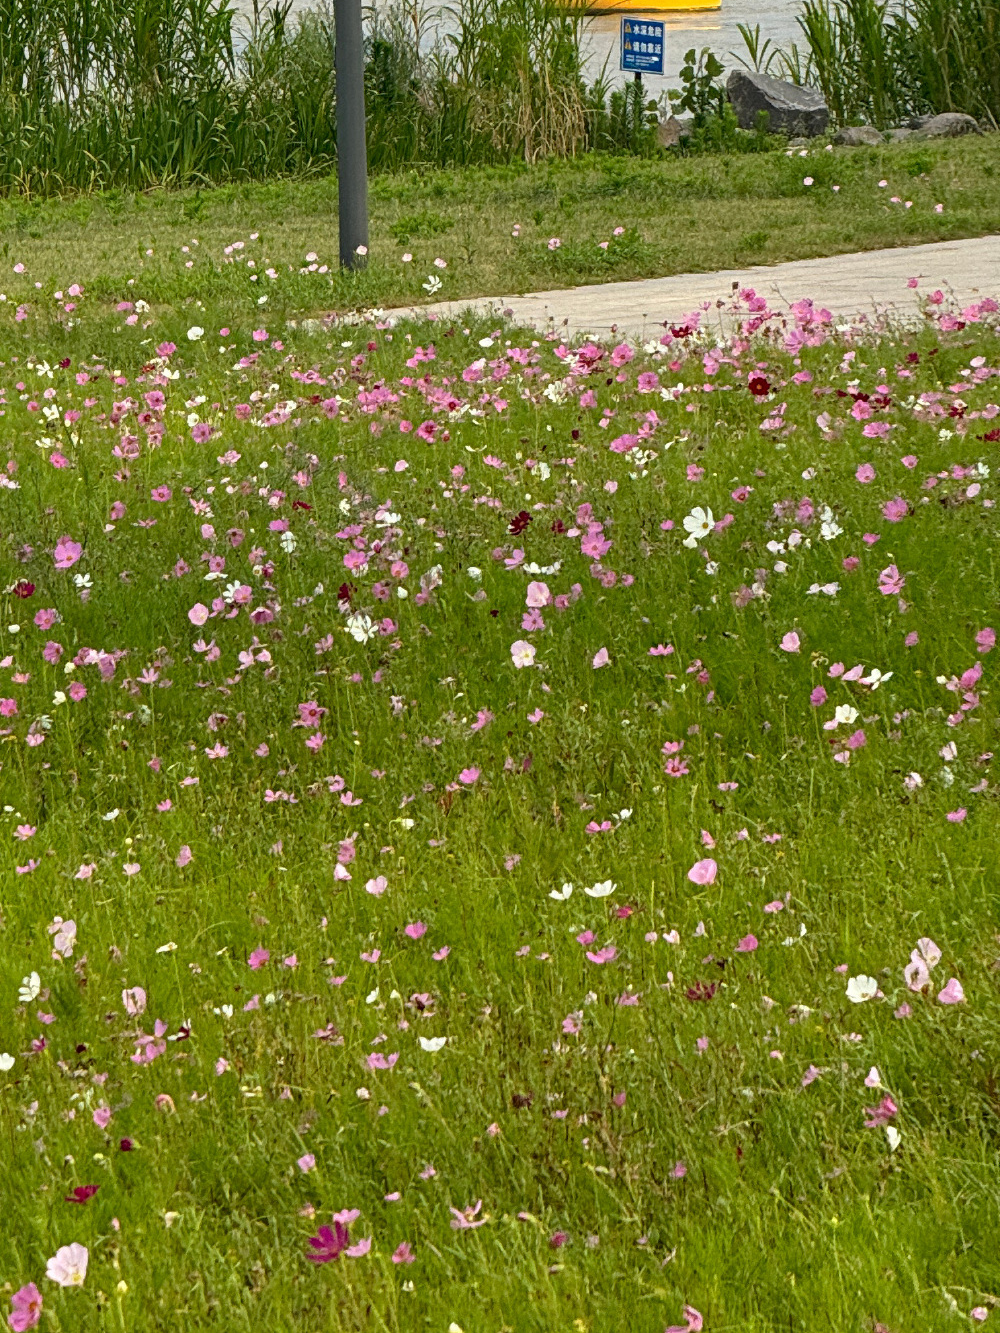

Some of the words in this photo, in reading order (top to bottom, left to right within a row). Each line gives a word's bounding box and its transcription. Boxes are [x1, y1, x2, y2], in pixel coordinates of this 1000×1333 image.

[633, 24, 662, 37] 水深危险
[633, 41, 662, 54] 请勿靠近
